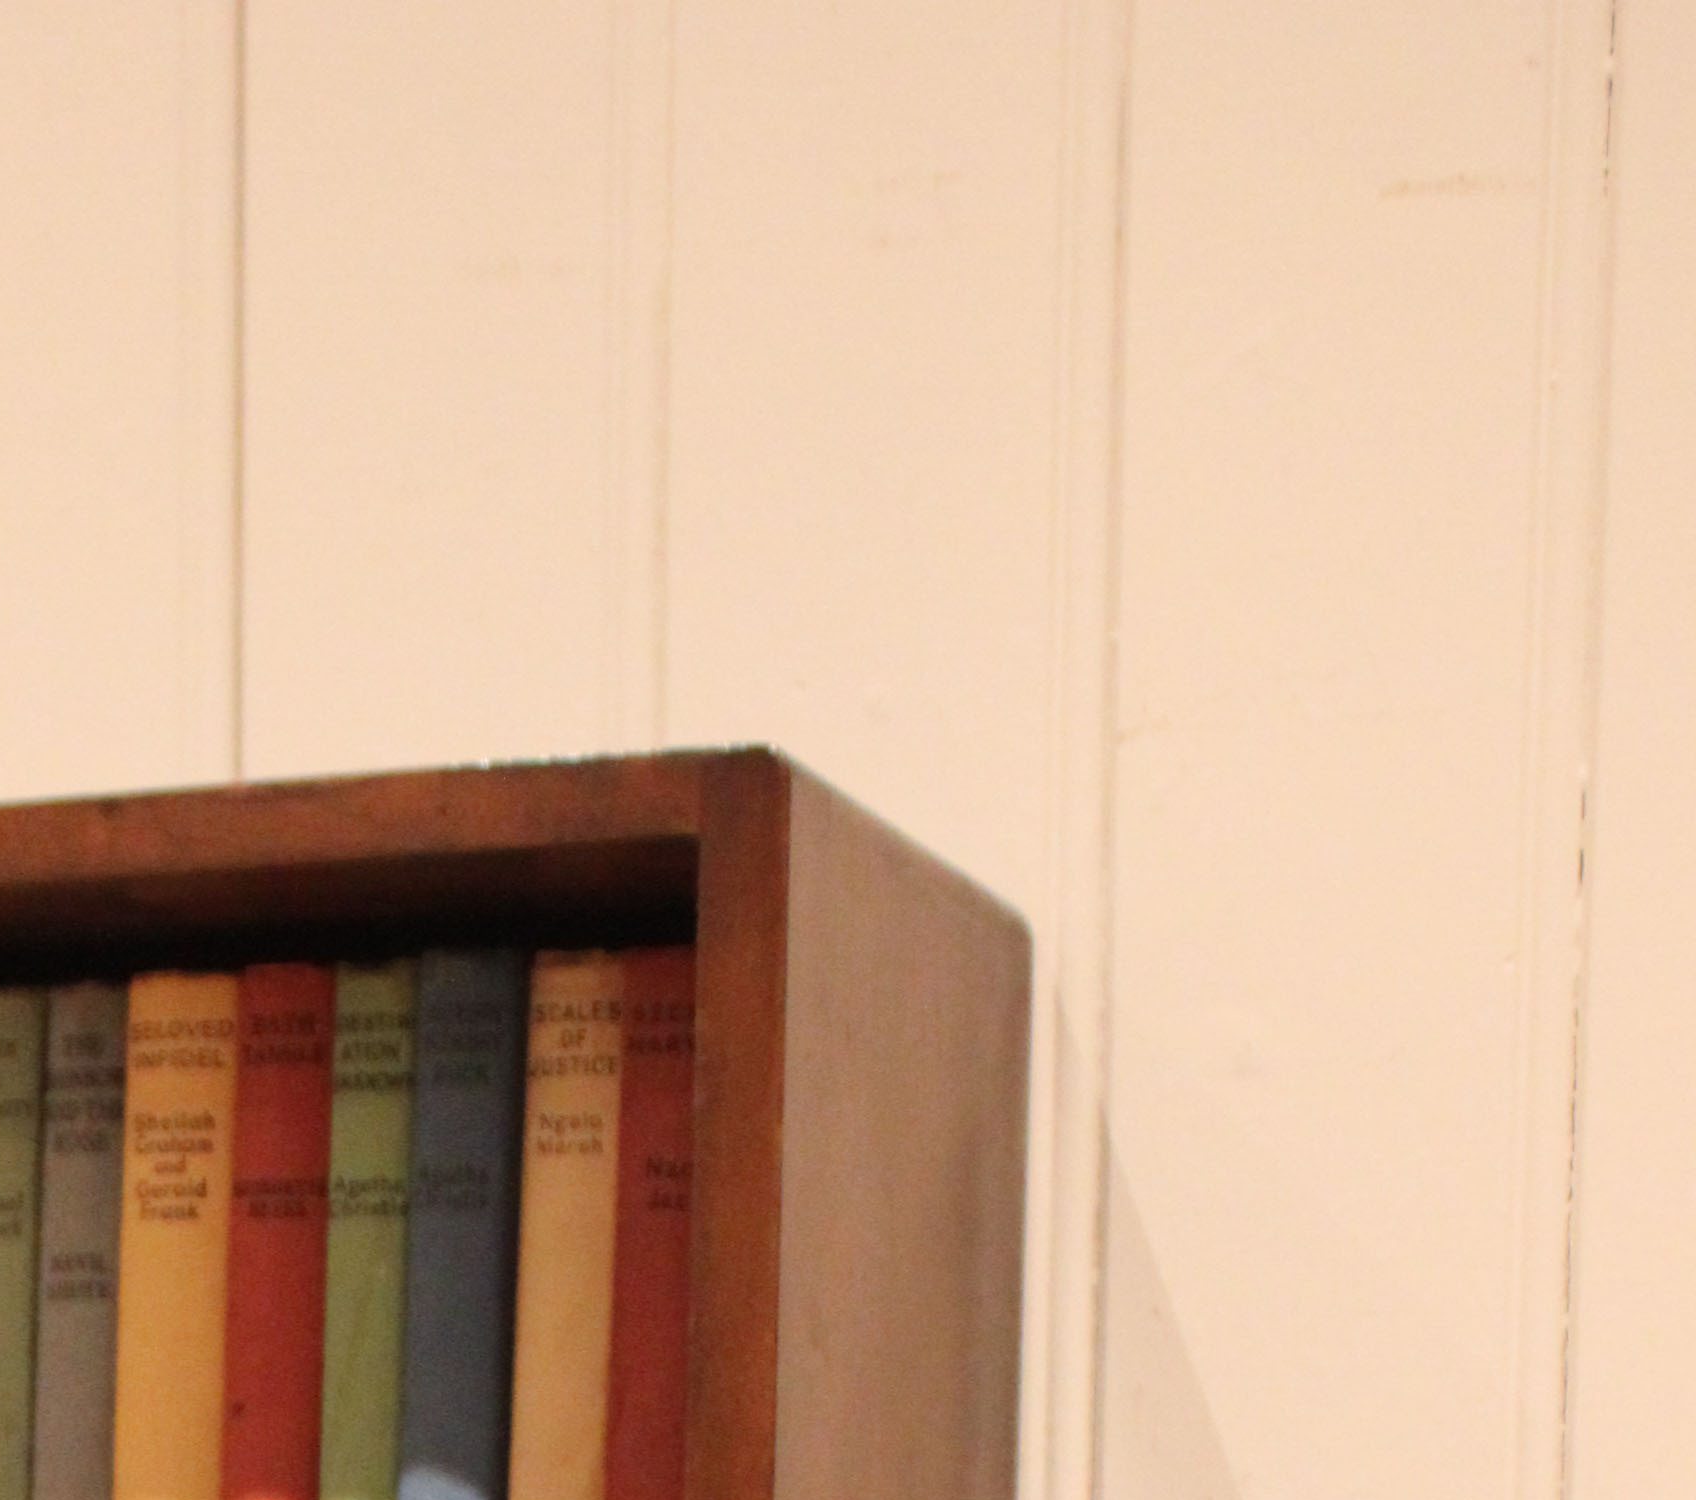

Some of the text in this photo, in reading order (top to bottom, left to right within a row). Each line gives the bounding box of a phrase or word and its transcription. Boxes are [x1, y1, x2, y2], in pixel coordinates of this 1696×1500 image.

[533, 1001, 621, 1022] SCALES
[130, 1019, 234, 1039] BELOVED
[561, 1029, 587, 1049] OF
[133, 1047, 226, 1069] INFIDEL
[154, 1154, 186, 1173] and
[139, 1200, 199, 1221] Frank
